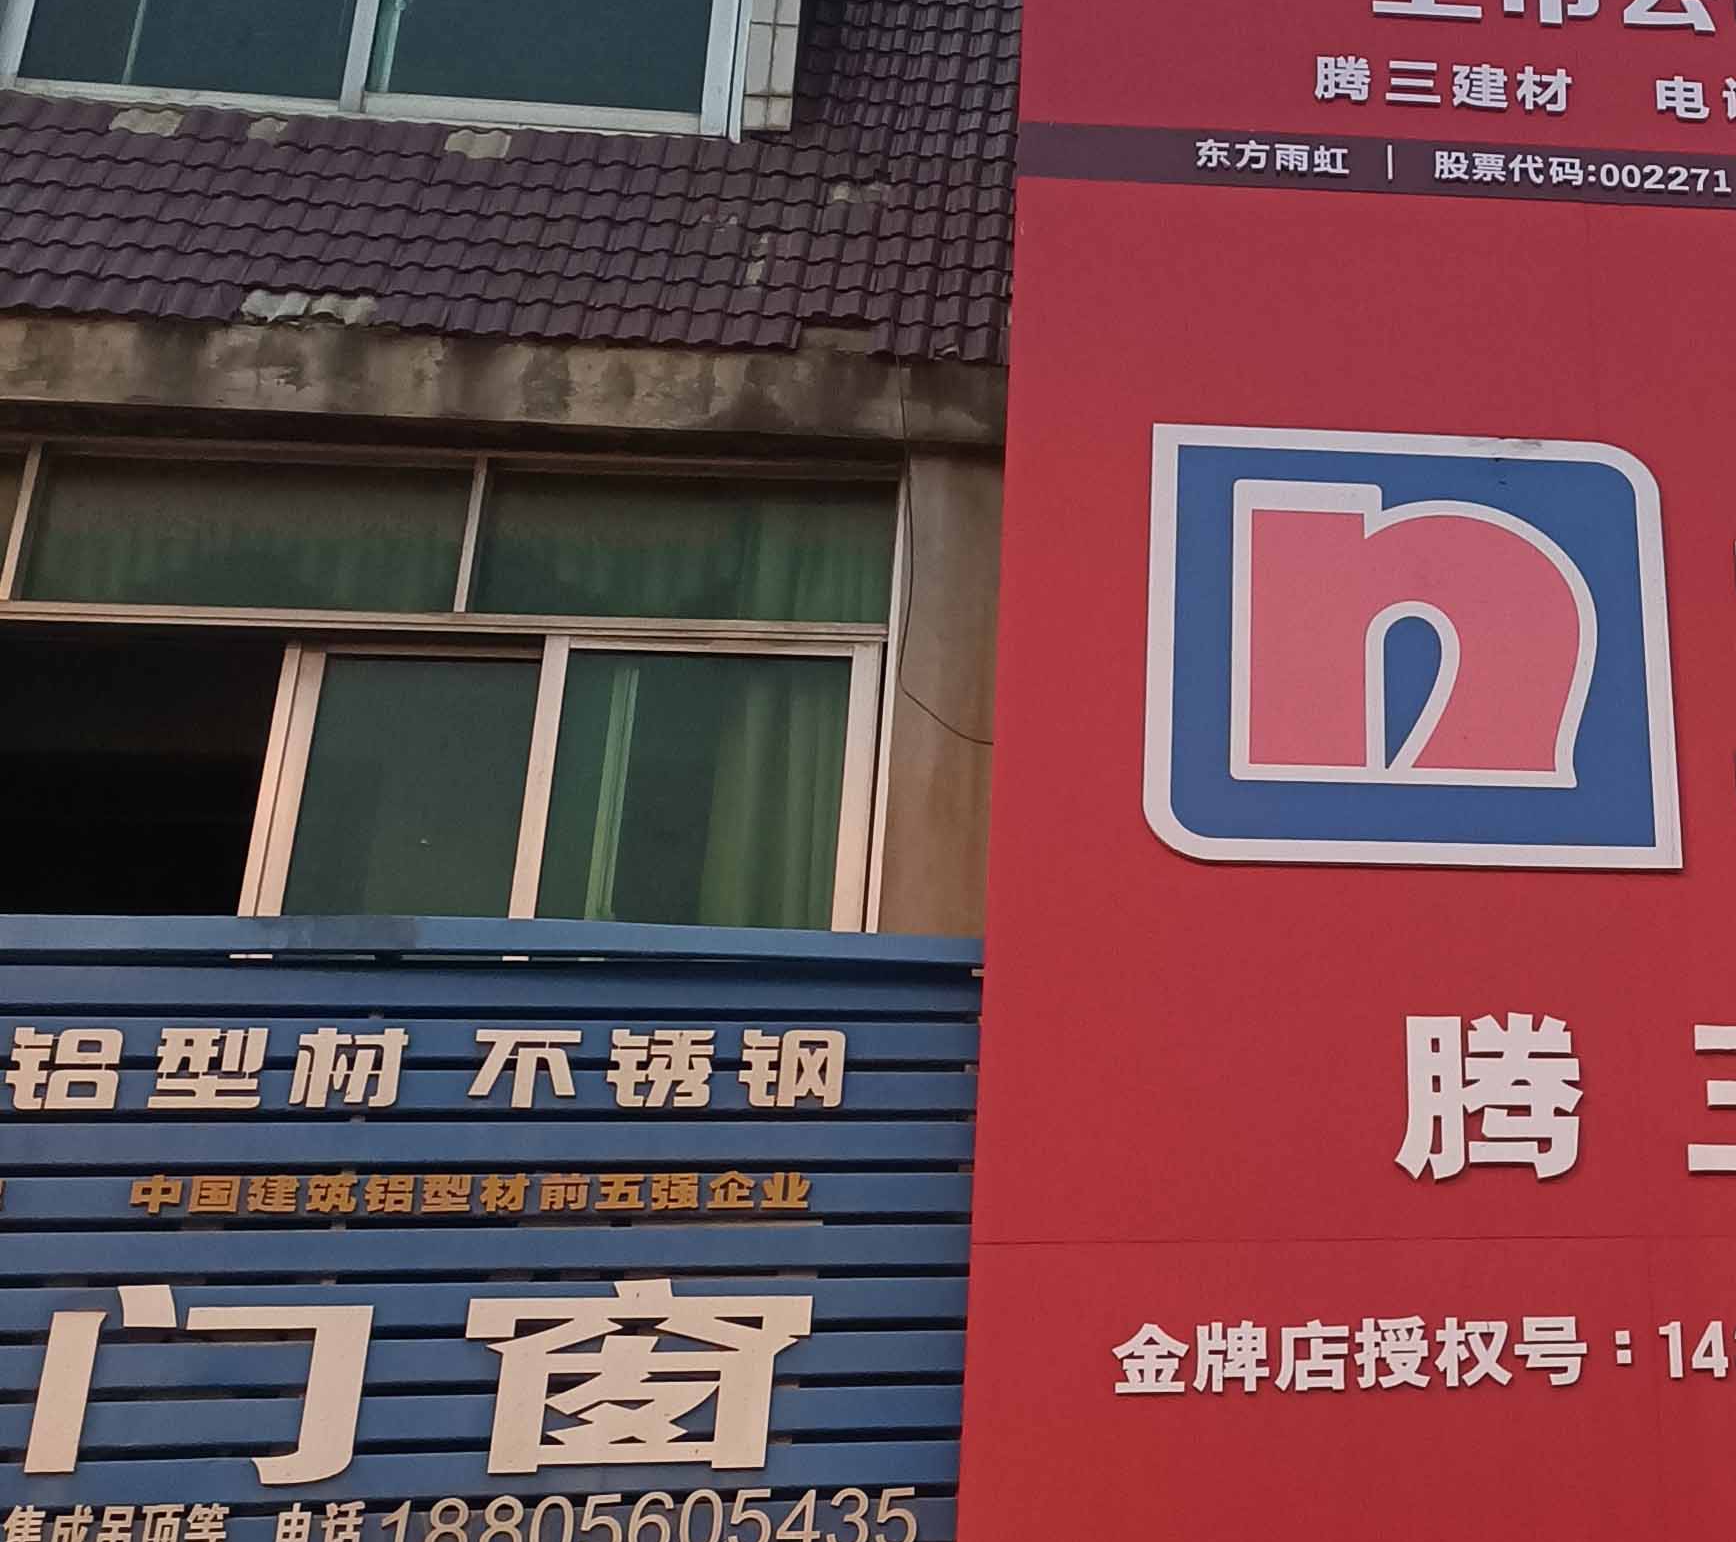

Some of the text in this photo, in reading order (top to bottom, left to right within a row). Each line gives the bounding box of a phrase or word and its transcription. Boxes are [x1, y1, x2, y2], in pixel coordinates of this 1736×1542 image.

[1314, 56, 1573, 114] 腾三建材
[1196, 139, 1351, 177] 东方雨虹
[1434, 151, 1732, 195] 股票代码:002271
[4, 1027, 848, 1110] 铝型材 不锈钢
[129, 1171, 812, 1216] 中国建筑铝型材前五强企业
[23, 1279, 814, 1487] 门窗
